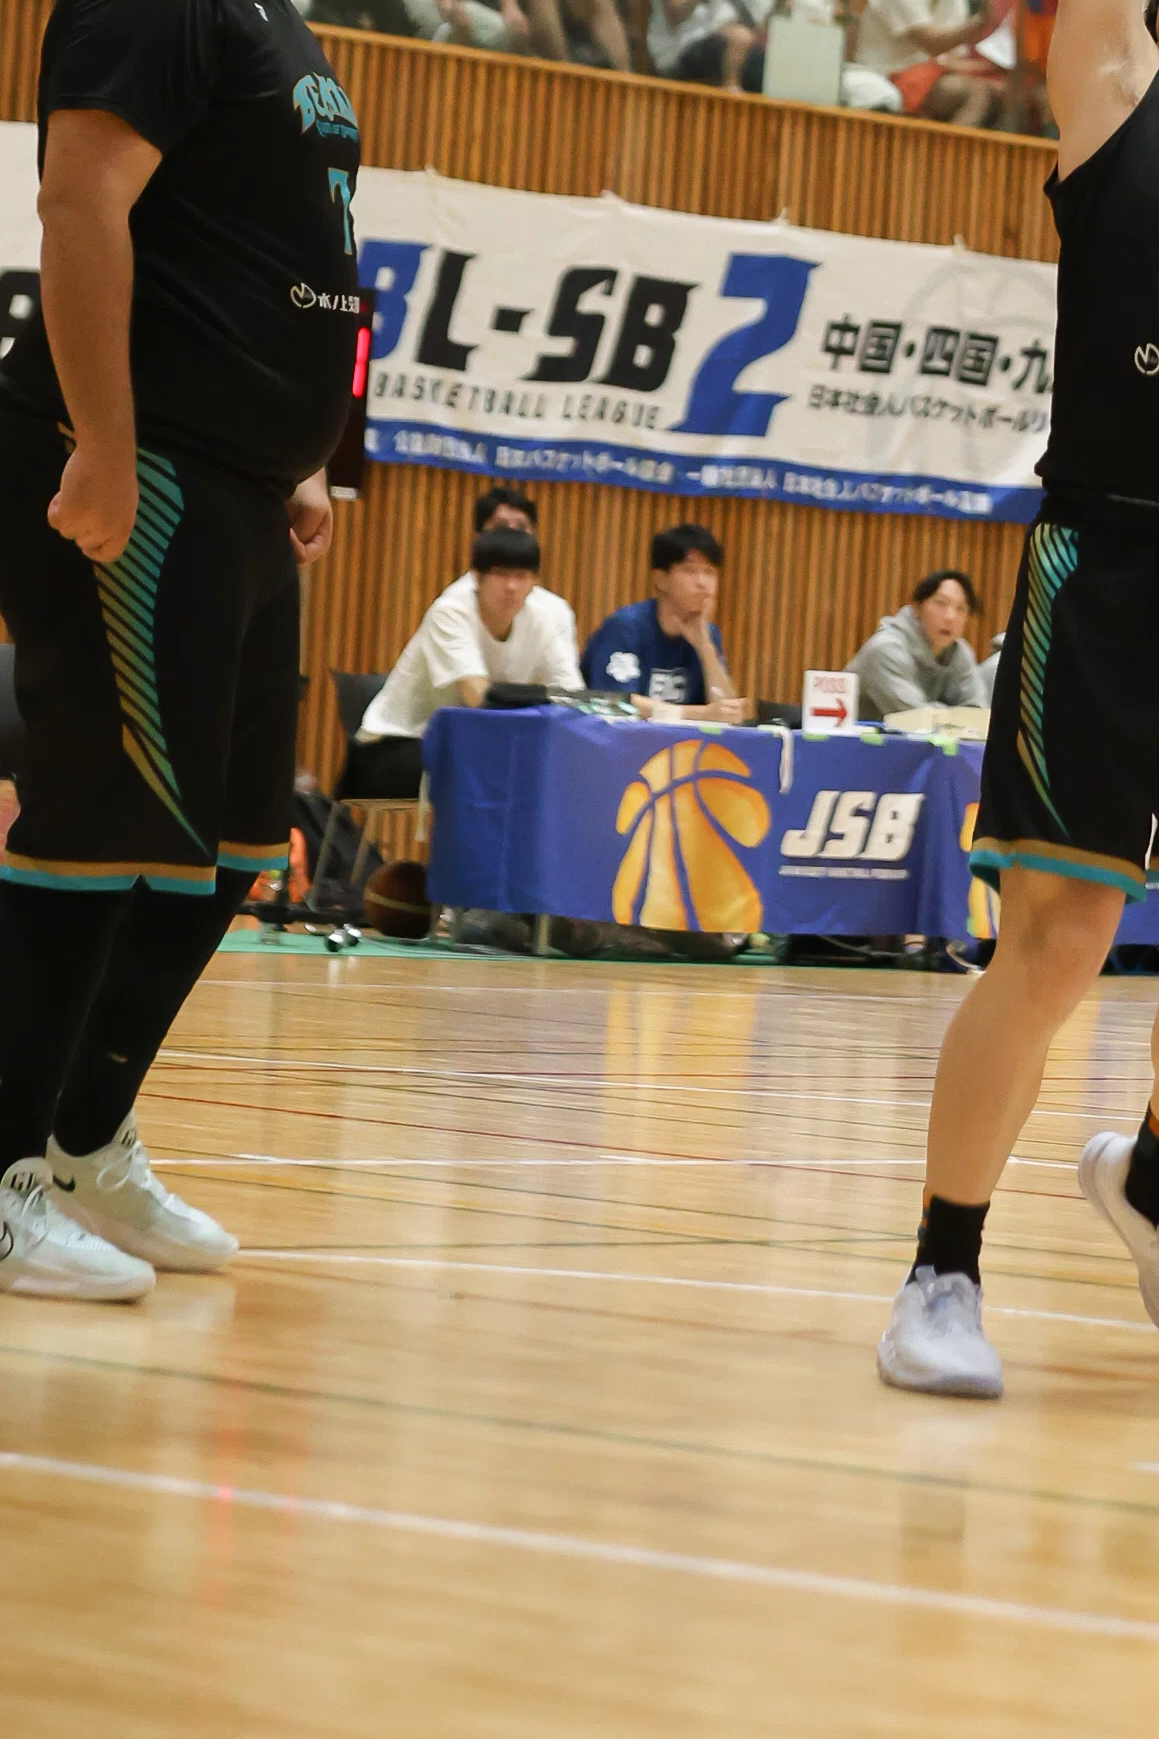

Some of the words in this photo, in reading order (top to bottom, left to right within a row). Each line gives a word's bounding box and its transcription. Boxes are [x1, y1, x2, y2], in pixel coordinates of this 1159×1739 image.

[327, 166, 353, 256] 7
[372, 371, 546, 420] BASKETBALL
[561, 393, 665, 431] LEAGUE
[780, 789, 926, 862] JSB
